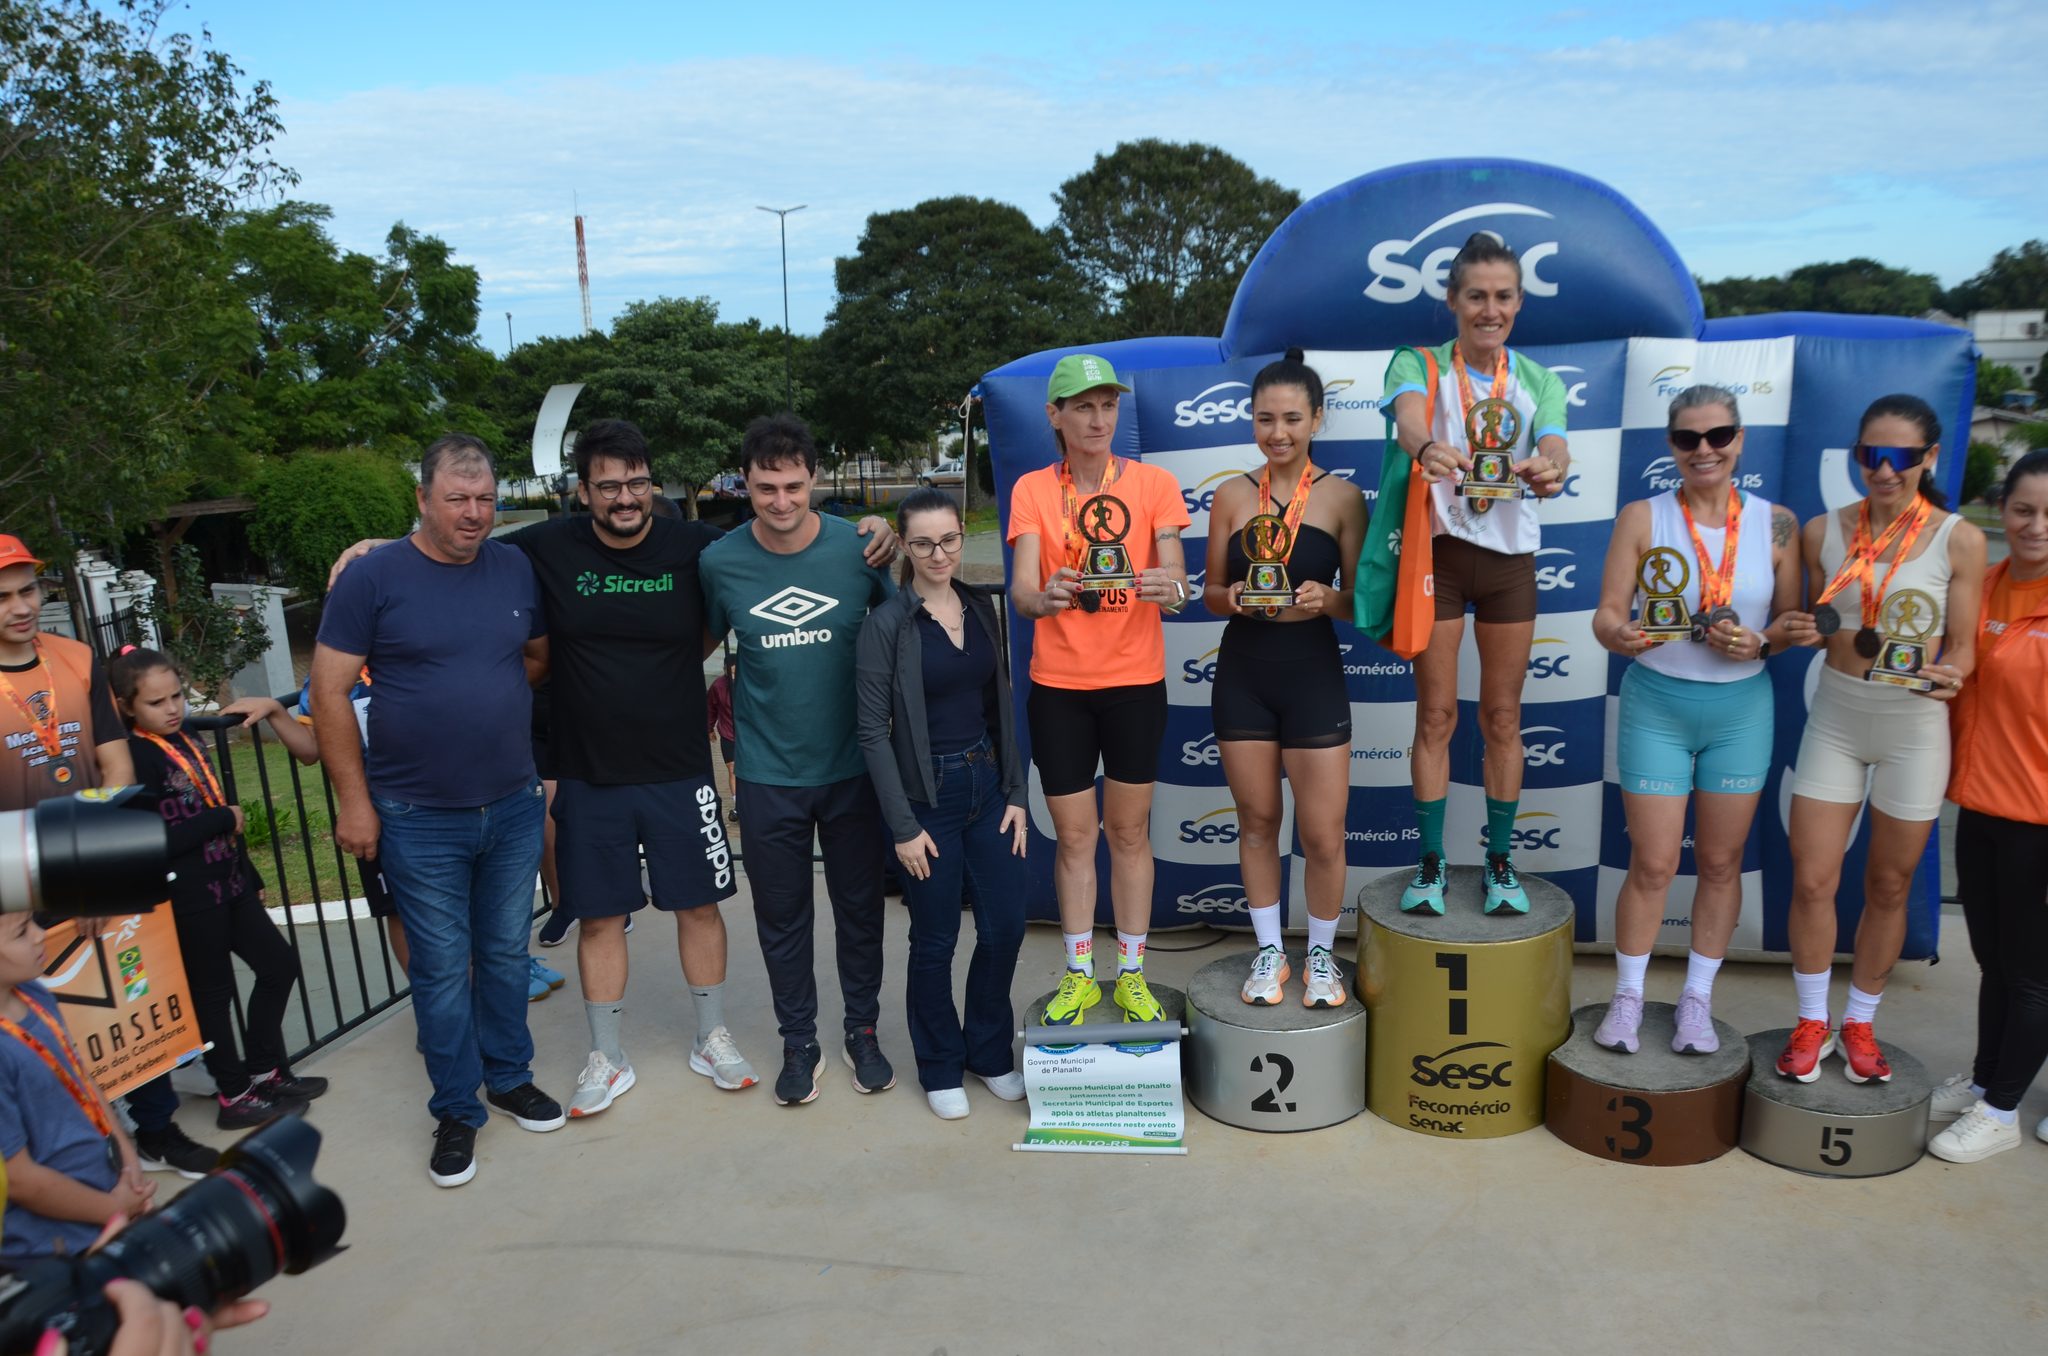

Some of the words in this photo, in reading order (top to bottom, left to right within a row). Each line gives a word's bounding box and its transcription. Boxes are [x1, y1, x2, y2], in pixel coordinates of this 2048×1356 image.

[1364, 239, 1559, 304] Sec
[1752, 381, 1773, 395] RS
[1327, 397, 1383, 410] Fecomé
[1742, 473, 1764, 488] RS
[1182, 488, 1214, 514] Se
[603, 573, 673, 593] Sicredi
[1535, 564, 1577, 591] sc
[761, 628, 832, 649] umbro
[1183, 659, 1217, 684] Se
[1181, 741, 1222, 766] Se
[1639, 779, 1675, 792] RUN
[696, 785, 731, 889] adidas
[1179, 820, 1240, 844] Ses
[1401, 828, 1421, 840] RS
[1435, 952, 1468, 1035] 1
[86, 993, 182, 1062] ORSEB
[132, 1024, 188, 1057] Corredores
[1027, 1058, 1059, 1066] Governo
[1061, 1057, 1096, 1066] Municipal
[1041, 1066, 1051, 1074] de
[1410, 1055, 1513, 1090] Sesc
[1250, 1052, 1297, 1113] 2
[1051, 1109, 1073, 1118] apoia
[1086, 1109, 1114, 1117] atletas
[1115, 1109, 1166, 1118] planaltenses
[1085, 1100, 1123, 1108] Municipal
[1408, 1094, 1511, 1116] Fecomércio
[1409, 1114, 1464, 1134] Senac
[1605, 1095, 1654, 1160] 3
[1819, 1126, 1854, 1167] 5
